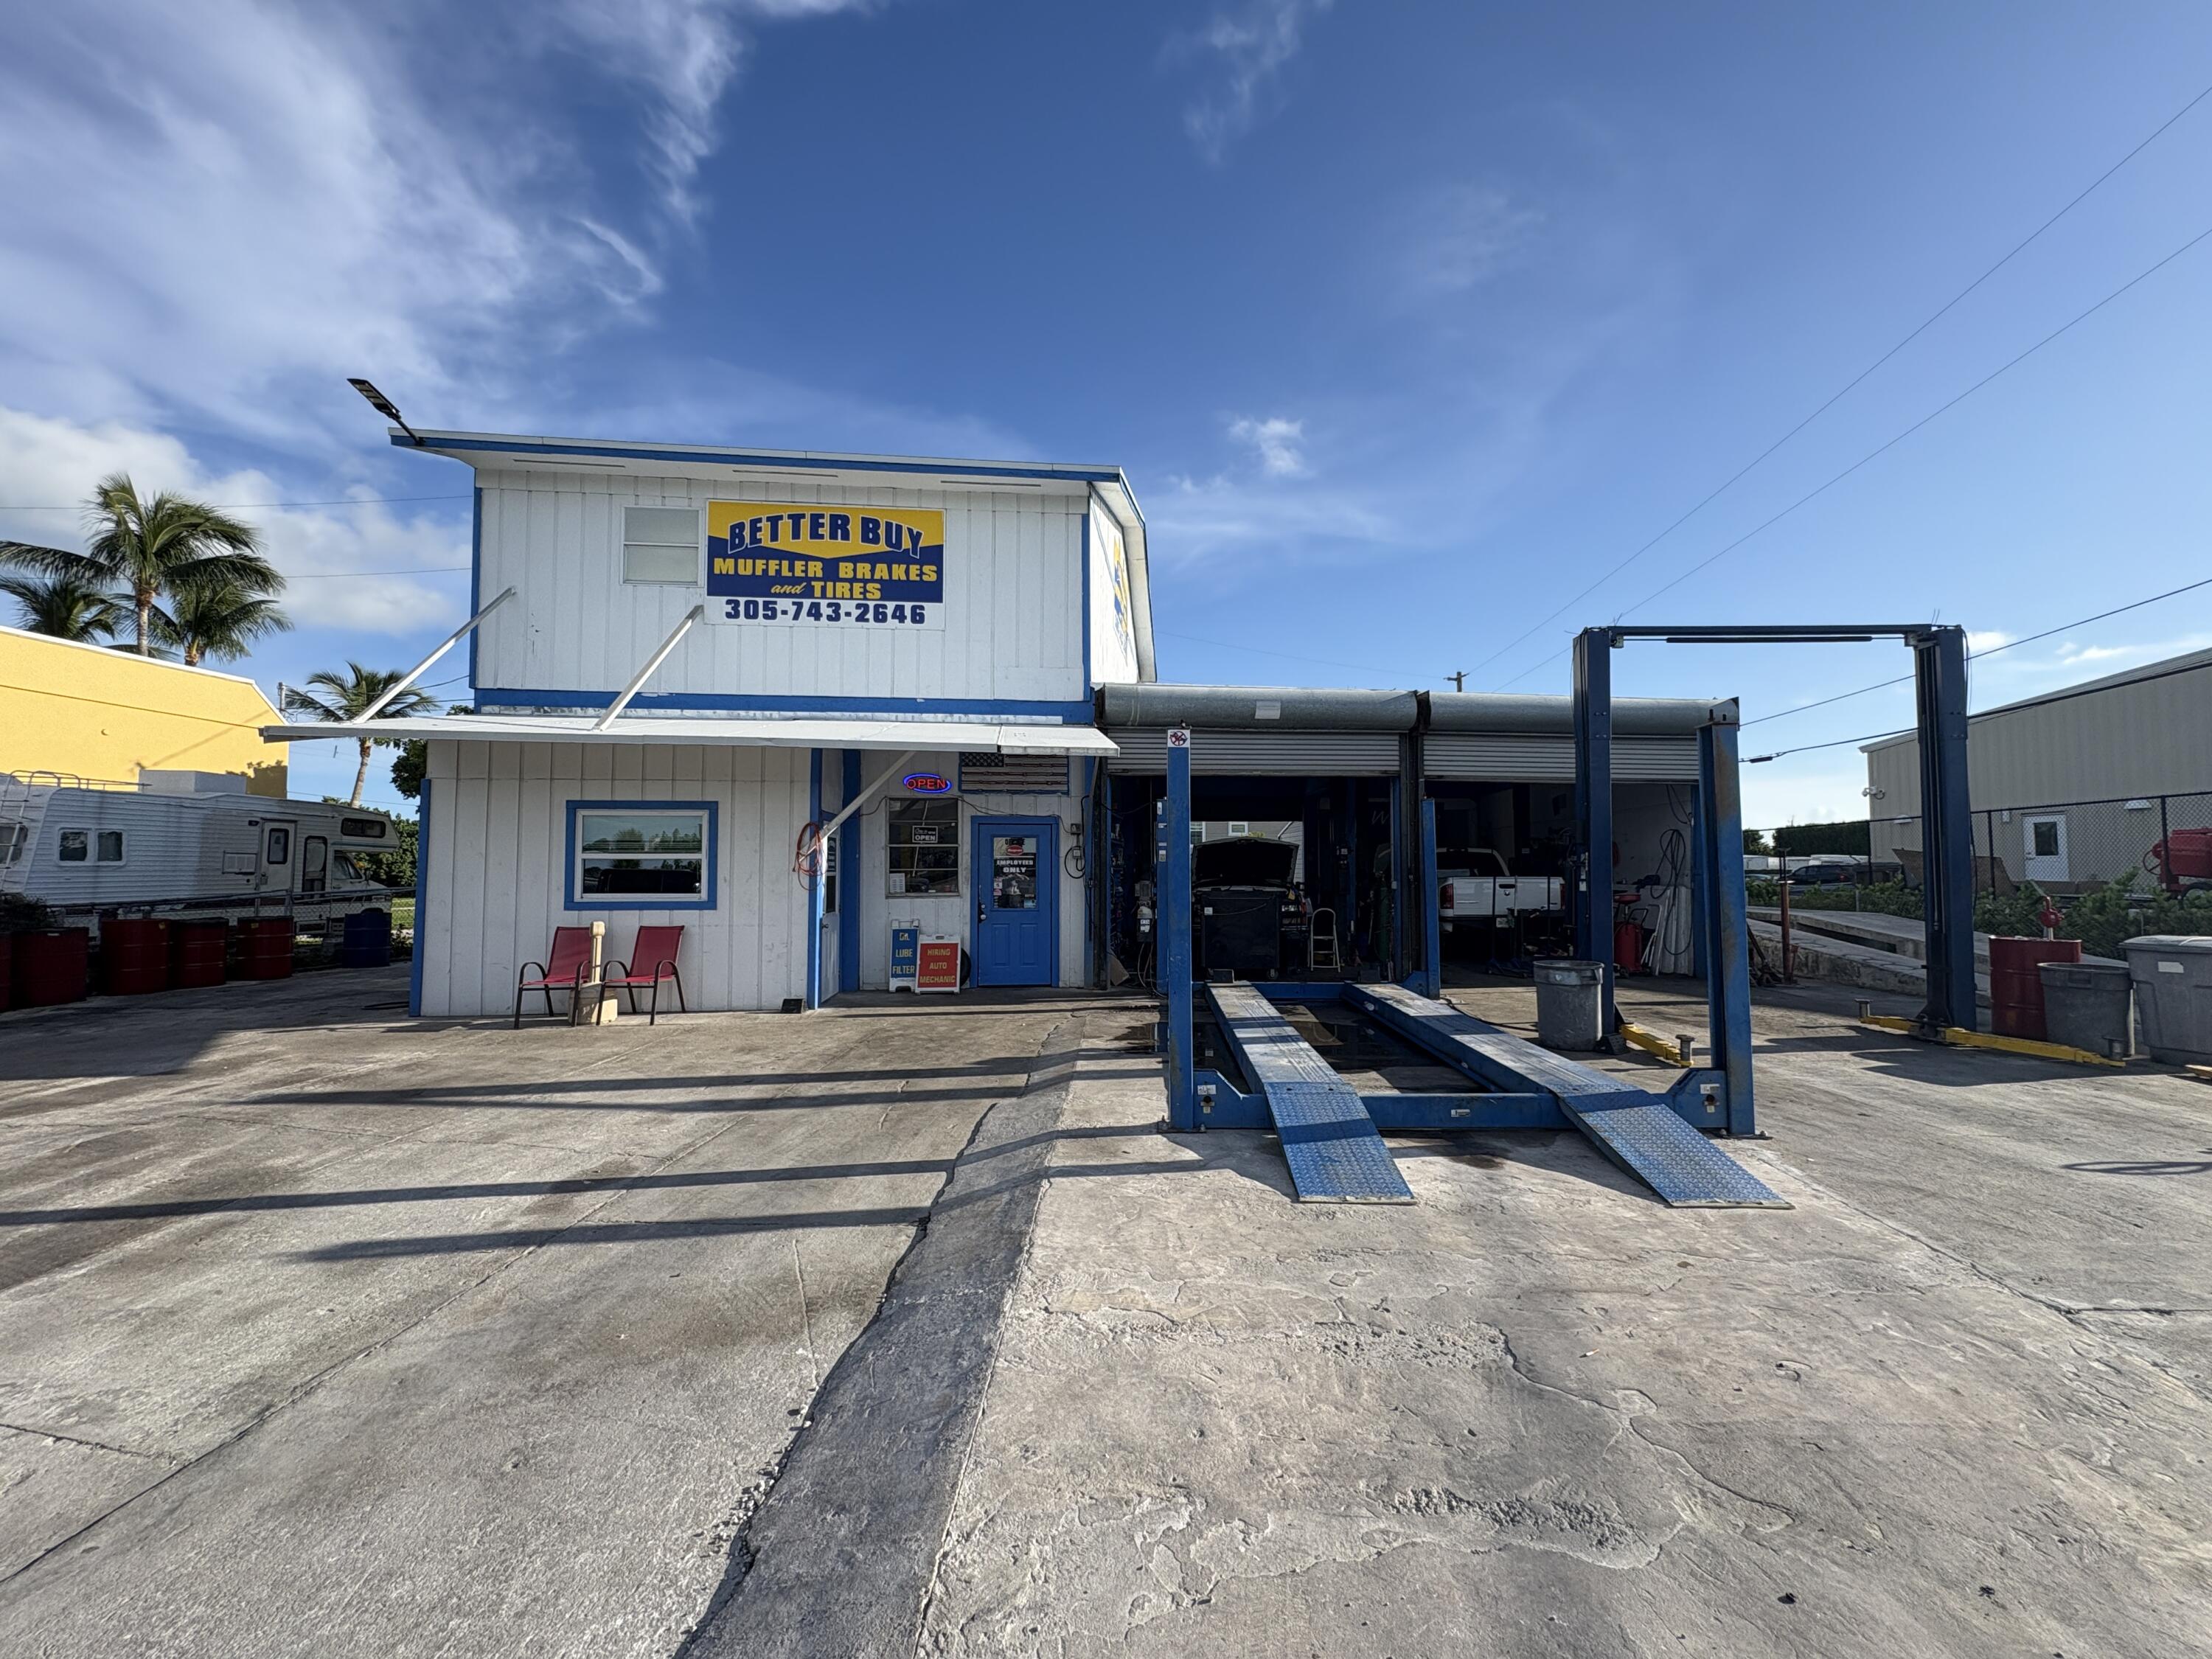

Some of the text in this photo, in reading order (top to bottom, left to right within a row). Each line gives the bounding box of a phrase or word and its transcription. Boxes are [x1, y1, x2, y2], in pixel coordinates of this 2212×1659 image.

[728, 512, 924, 559] BETTER BUY
[714, 557, 938, 582] MUFFLER BRAKES
[771, 581, 881, 600] and TIRES
[725, 599, 925, 625] 305-743-2646
[906, 779, 946, 789] OPEN
[895, 948, 914, 958] LUBE
[927, 948, 951, 956] HIRING
[892, 964, 915, 974] FILTER
[929, 961, 947, 970] AUTO
